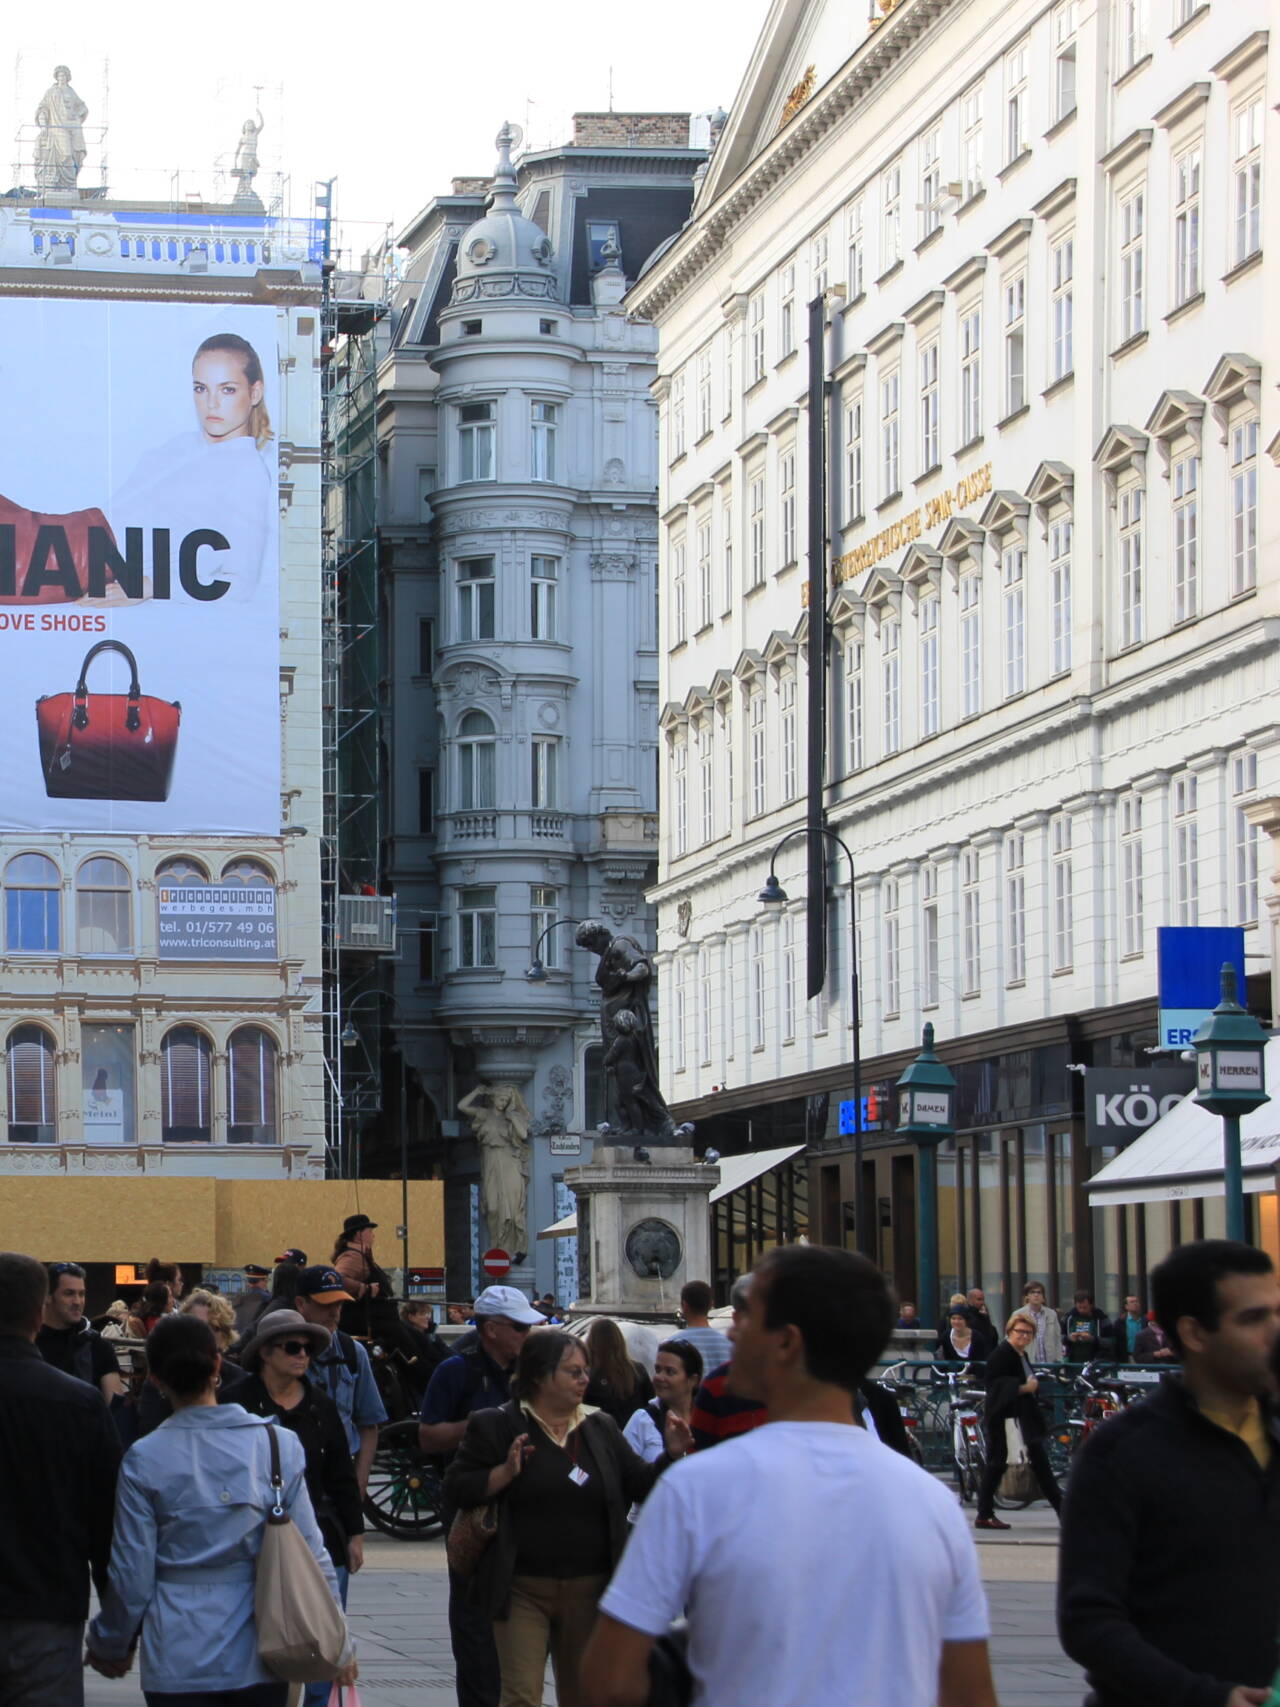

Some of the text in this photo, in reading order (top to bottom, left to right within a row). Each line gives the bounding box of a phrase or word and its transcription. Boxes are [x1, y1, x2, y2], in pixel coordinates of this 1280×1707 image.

[40, 614, 106, 633] SHOES
[161, 889, 273, 904] triconsulting
[160, 920, 275, 934] tel. 01/577 49 06
[160, 937, 275, 950] www.triconsulting.at
[1219, 1065, 1259, 1076] HERREN
[916, 1103, 946, 1114] DAMEN
